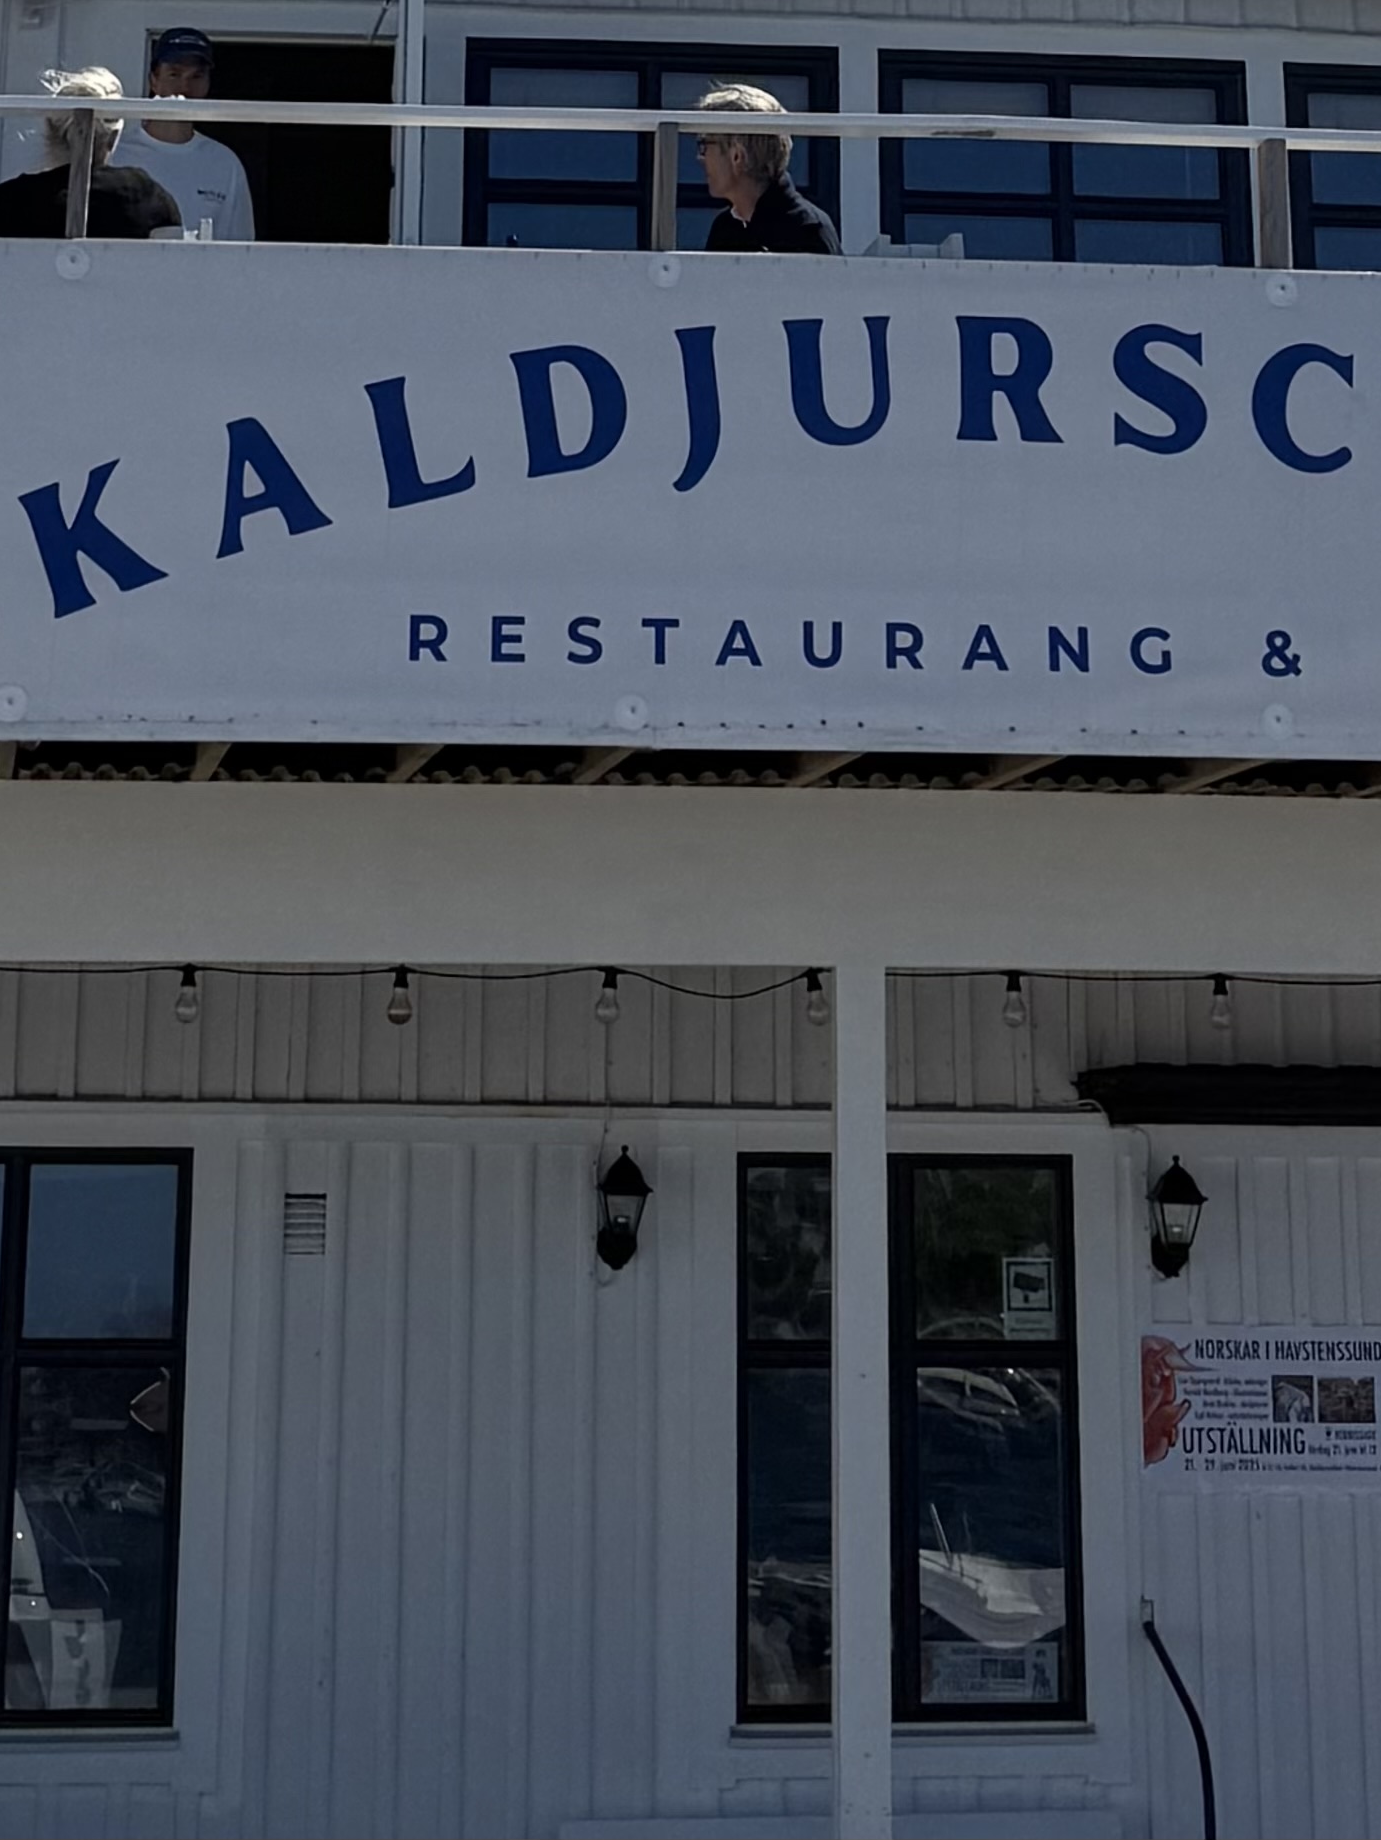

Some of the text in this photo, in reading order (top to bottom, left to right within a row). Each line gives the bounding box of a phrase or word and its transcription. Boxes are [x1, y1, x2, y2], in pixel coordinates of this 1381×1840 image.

[410, 615, 1171, 674] RESTAURANG
[1262, 631, 1300, 677] &
[1194, 1339, 1261, 1360] NORSKAR
[1265, 1340, 1270, 1360] I
[1182, 1421, 1306, 1455] UTSTÄLLNING
